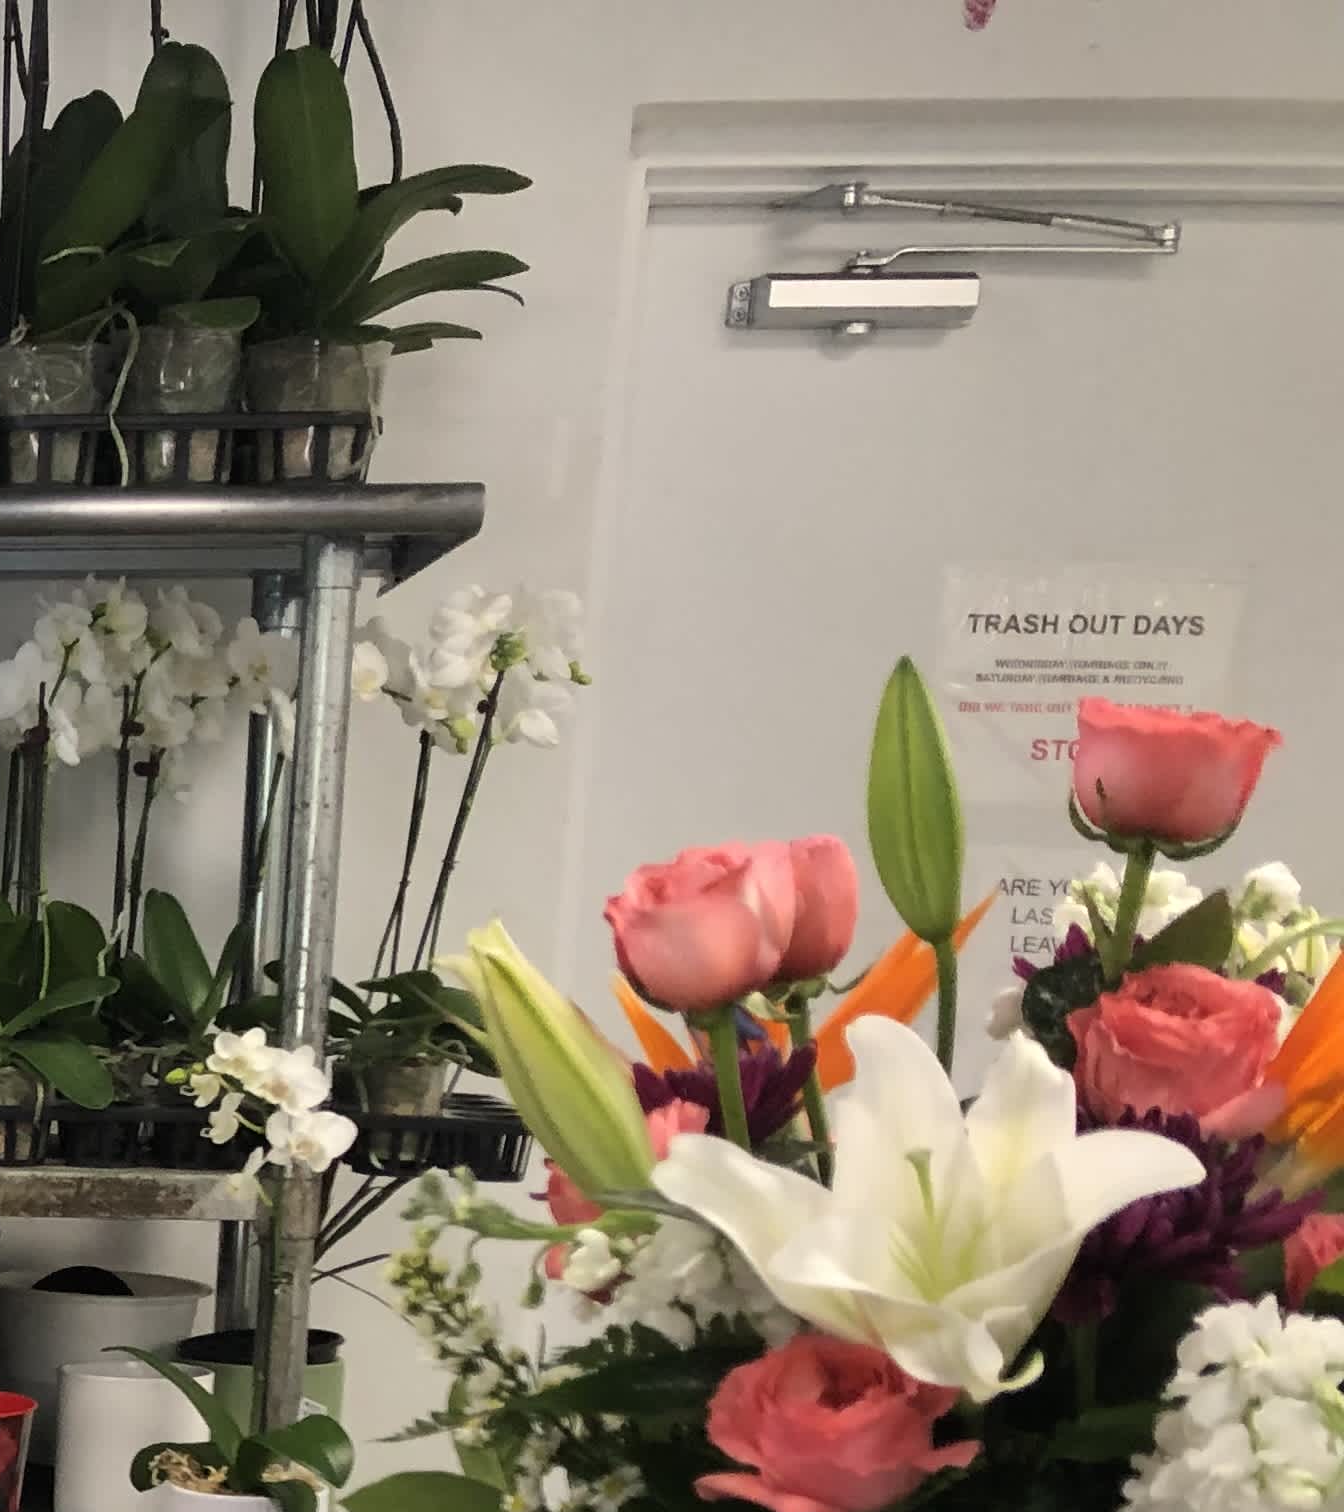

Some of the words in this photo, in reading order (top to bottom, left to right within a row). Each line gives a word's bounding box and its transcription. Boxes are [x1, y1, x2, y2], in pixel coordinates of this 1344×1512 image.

[968, 613, 1059, 635] TRASH
[1069, 613, 1123, 635] OUT
[1133, 614, 1205, 636] DAYS
[1000, 878, 1042, 896] ARE
